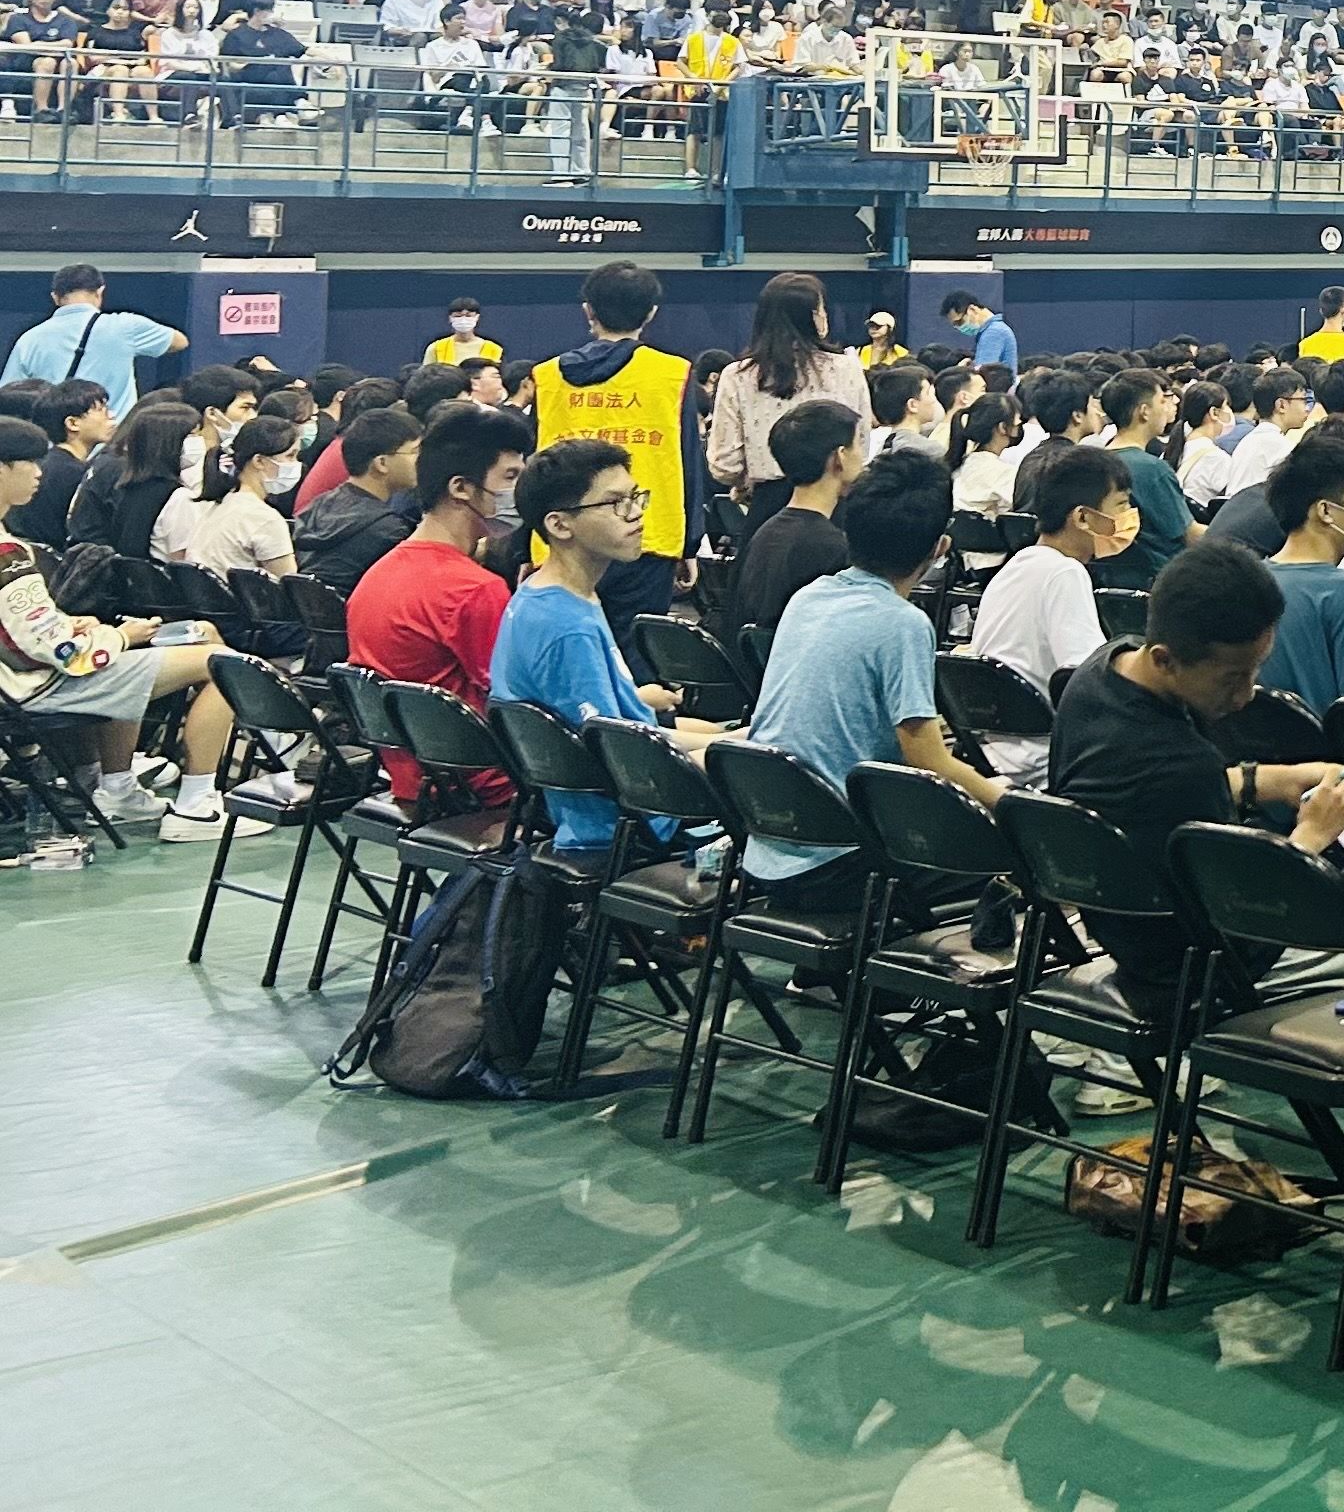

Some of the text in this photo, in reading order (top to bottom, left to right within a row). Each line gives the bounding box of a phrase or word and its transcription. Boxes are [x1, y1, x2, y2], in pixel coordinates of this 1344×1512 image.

[522, 214, 642, 232] Own the Game.
[568, 392, 642, 409] 財團法人
